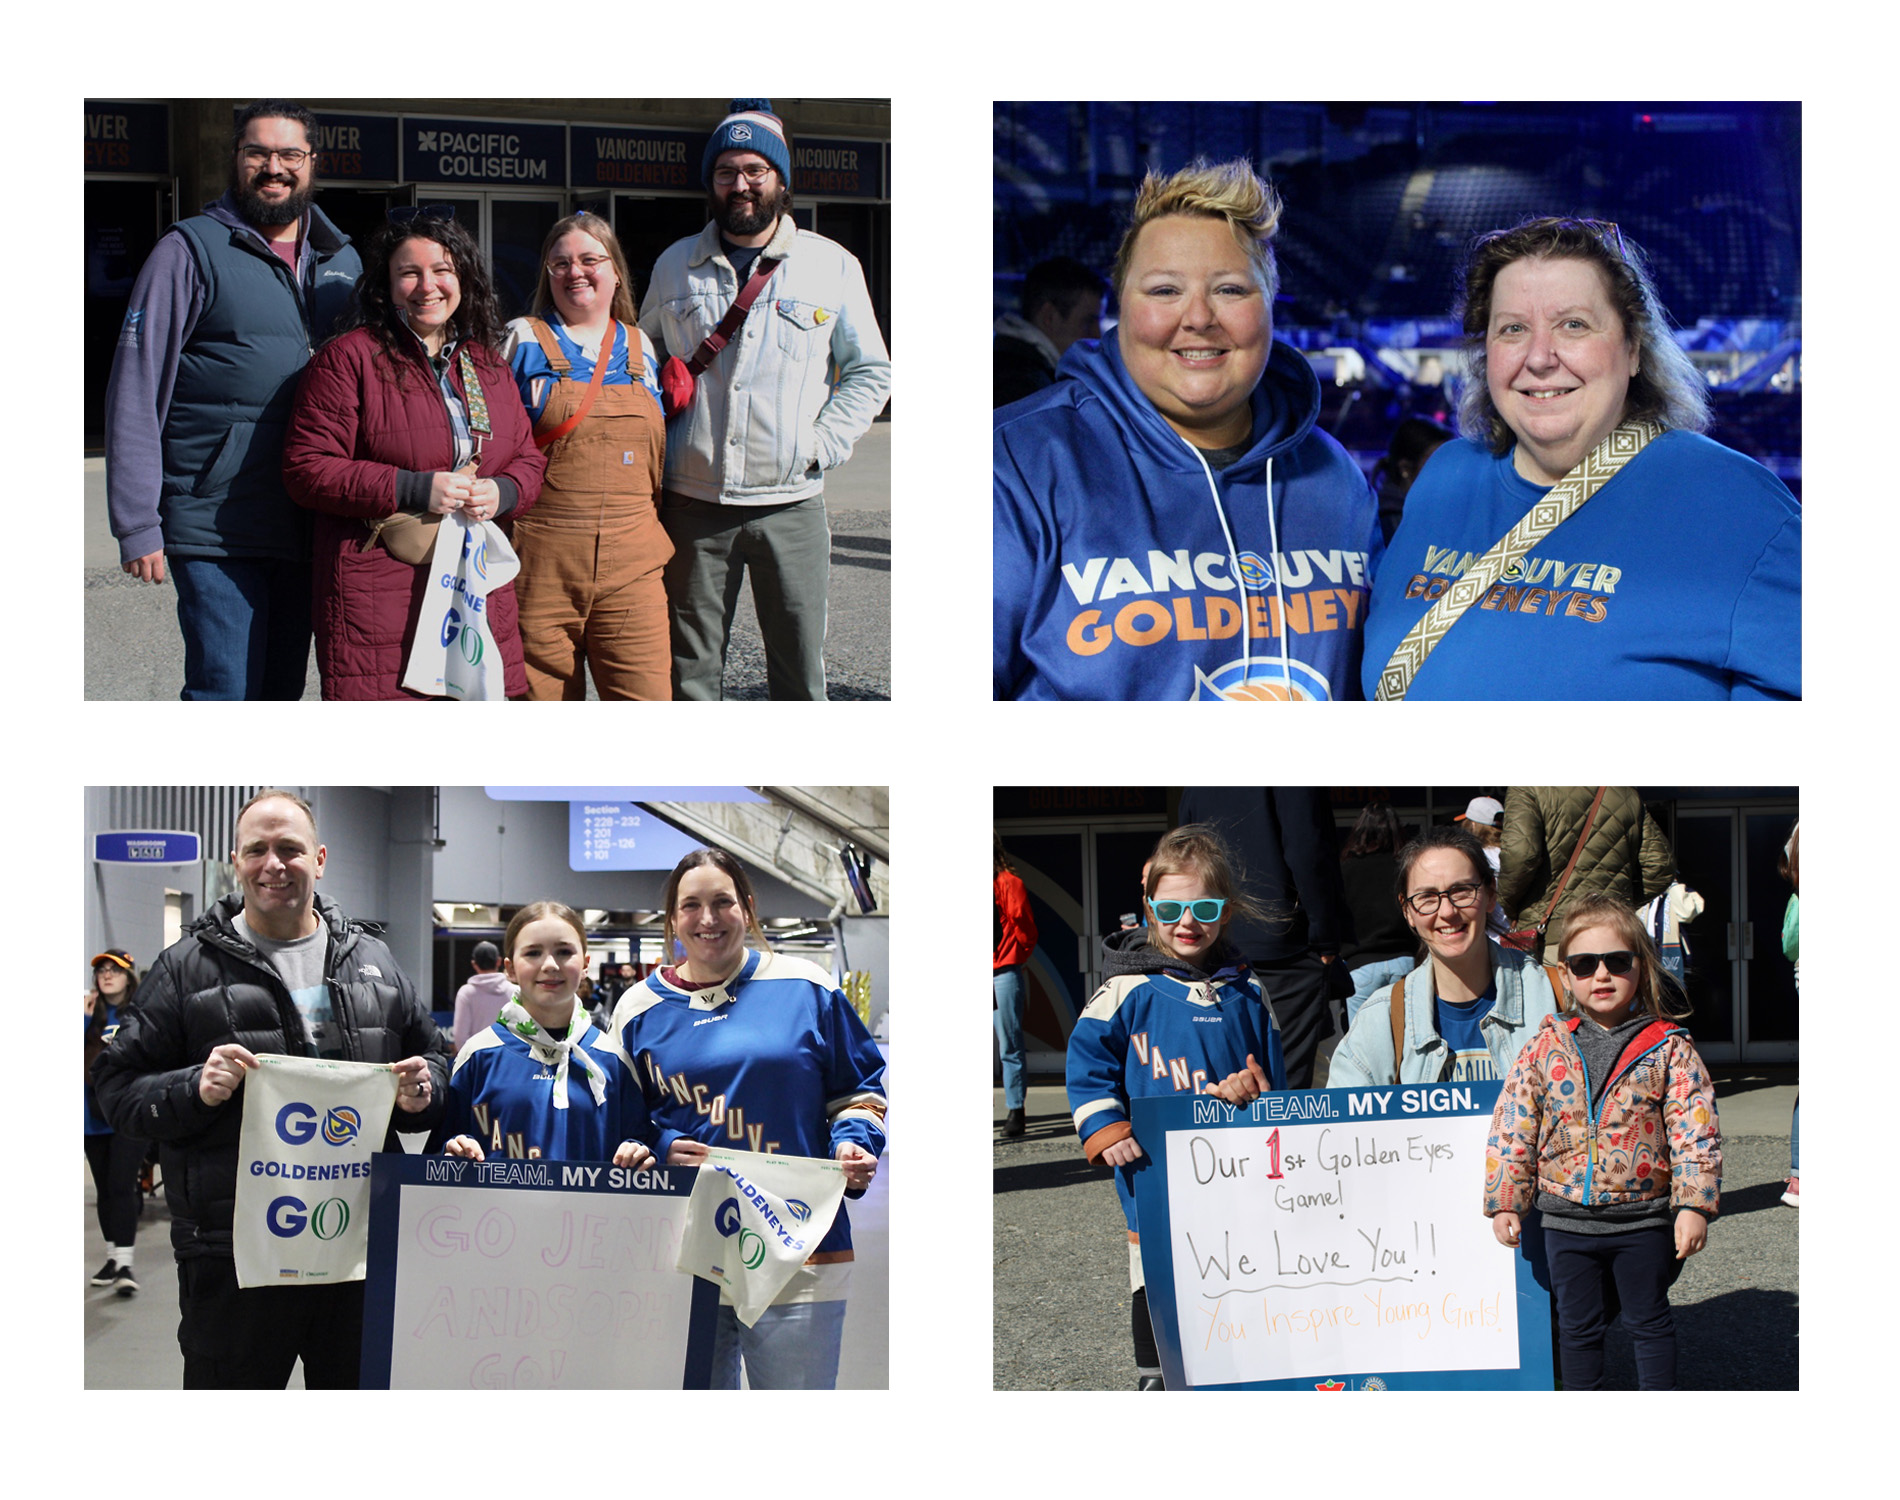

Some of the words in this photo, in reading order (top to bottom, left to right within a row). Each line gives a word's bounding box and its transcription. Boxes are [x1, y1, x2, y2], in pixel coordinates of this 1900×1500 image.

[84, 113, 129, 140] VER
[439, 131, 520, 156] PACIFIC
[595, 137, 687, 163] VANCOUVER
[792, 148, 858, 171] NCOUVER
[438, 155, 547, 180] COLISEUM
[595, 161, 688, 185] GOLDENEYES
[793, 169, 860, 191] LDENEYES
[1061, 549, 1374, 606] VANCOUVE
[1423, 545, 1622, 594] VANOUVER
[1405, 574, 1610, 623] GOENEYES
[1067, 589, 1361, 656] GOLDENEY
[584, 806, 621, 815] Section
[594, 829, 611, 838] 201
[594, 850, 609, 860] 101
[693, 1014, 729, 1027] BAUER
[1193, 1100, 1237, 1124] MY
[1252, 1095, 1339, 1121] TEAM.
[1348, 1093, 1393, 1116] MY
[1401, 1087, 1480, 1113] SIGN.
[250, 1160, 371, 1181] GOLDENEYES
[1190, 1136, 1250, 1185] Our
[1265, 1127, 1306, 1180] 1st
[1317, 1128, 1400, 1175] Golden
[1407, 1135, 1454, 1173] Eyes
[425, 1159, 469, 1182] MY
[472, 1162, 554, 1186] TEAM.
[561, 1166, 602, 1188] MY
[607, 1168, 676, 1191] SIGN.
[1274, 1180, 1345, 1220] Game!
[266, 1195, 350, 1241] GO
[416, 1205, 516, 1258] GO
[714, 1197, 766, 1270] GO
[1187, 1230, 1256, 1281] We
[1274, 1230, 1350, 1275] Love
[1357, 1221, 1437, 1276] You!!
[1199, 1299, 1246, 1351] You
[1264, 1297, 1360, 1342] Inspire
[1364, 1288, 1431, 1339] Young
[1441, 1291, 1502, 1334] Girls!
